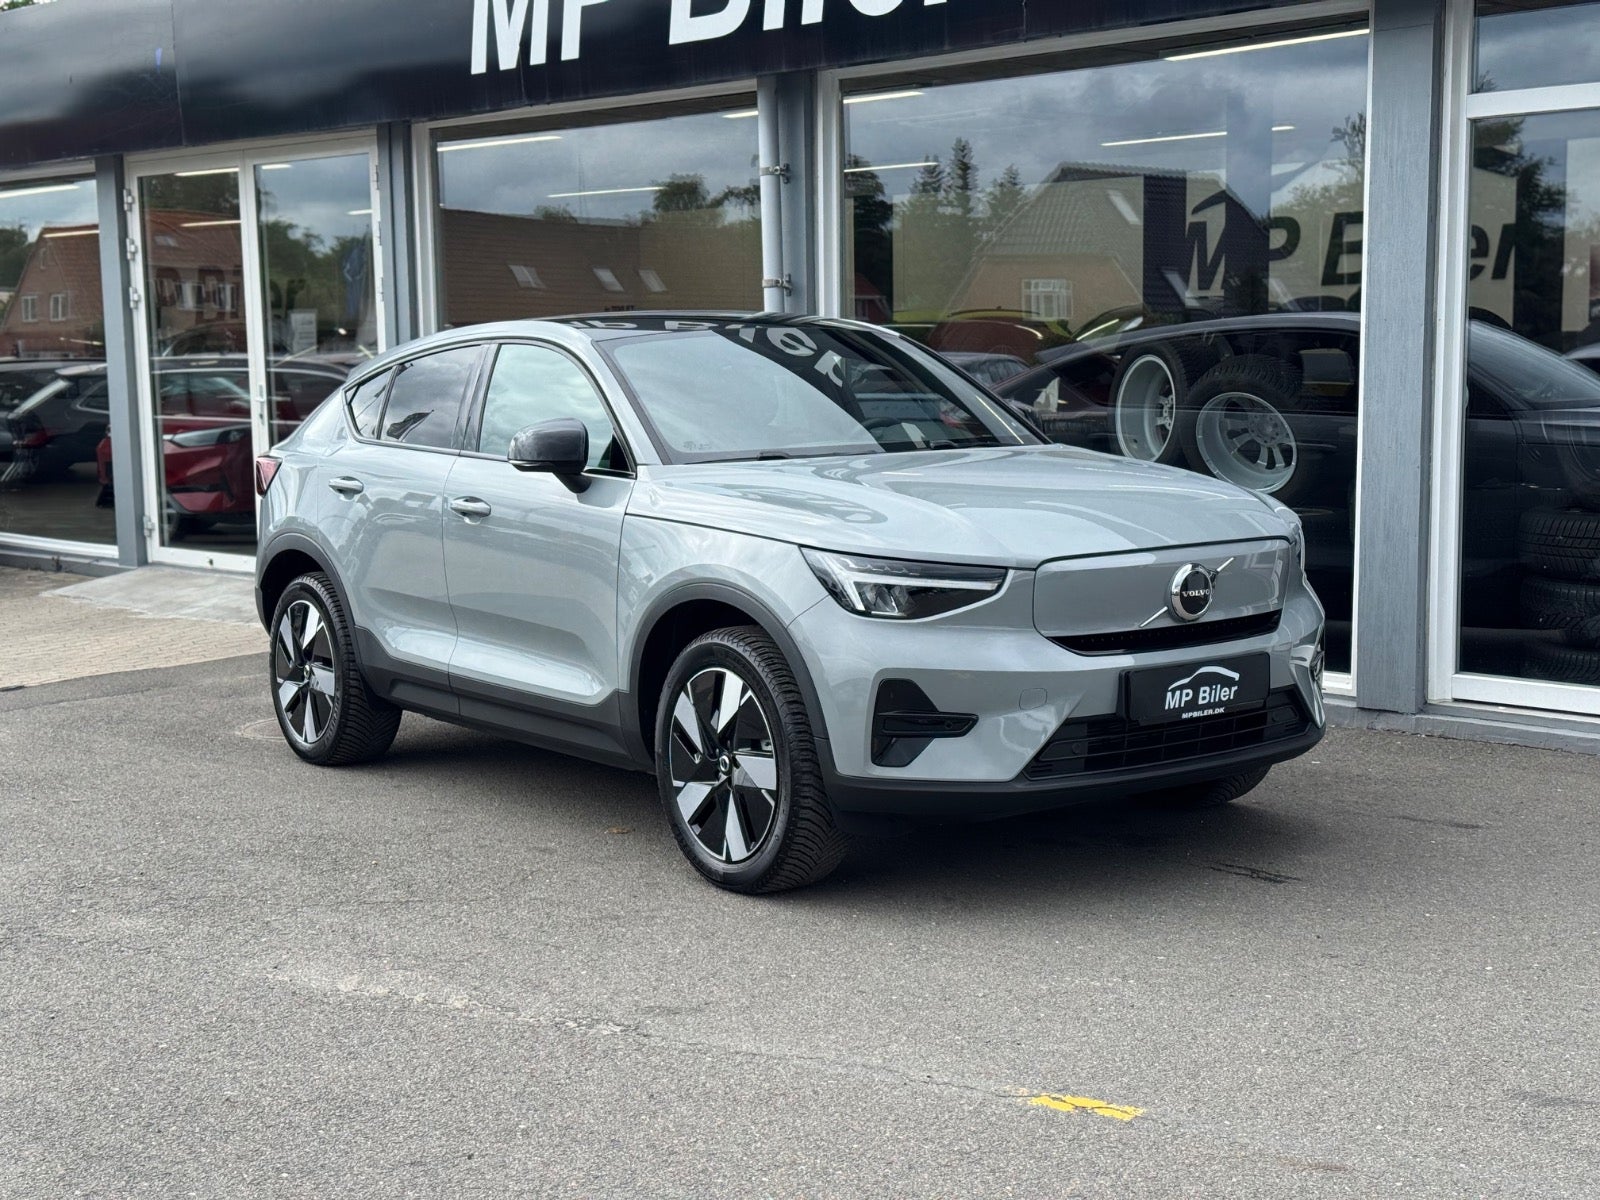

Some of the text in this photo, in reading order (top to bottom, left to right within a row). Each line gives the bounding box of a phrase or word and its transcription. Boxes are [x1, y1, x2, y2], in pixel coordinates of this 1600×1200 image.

[1181, 589, 1210, 598] VOLVO
[1165, 684, 1238, 710] MP Biler
[1181, 706, 1225, 719] MPBILER.DK
